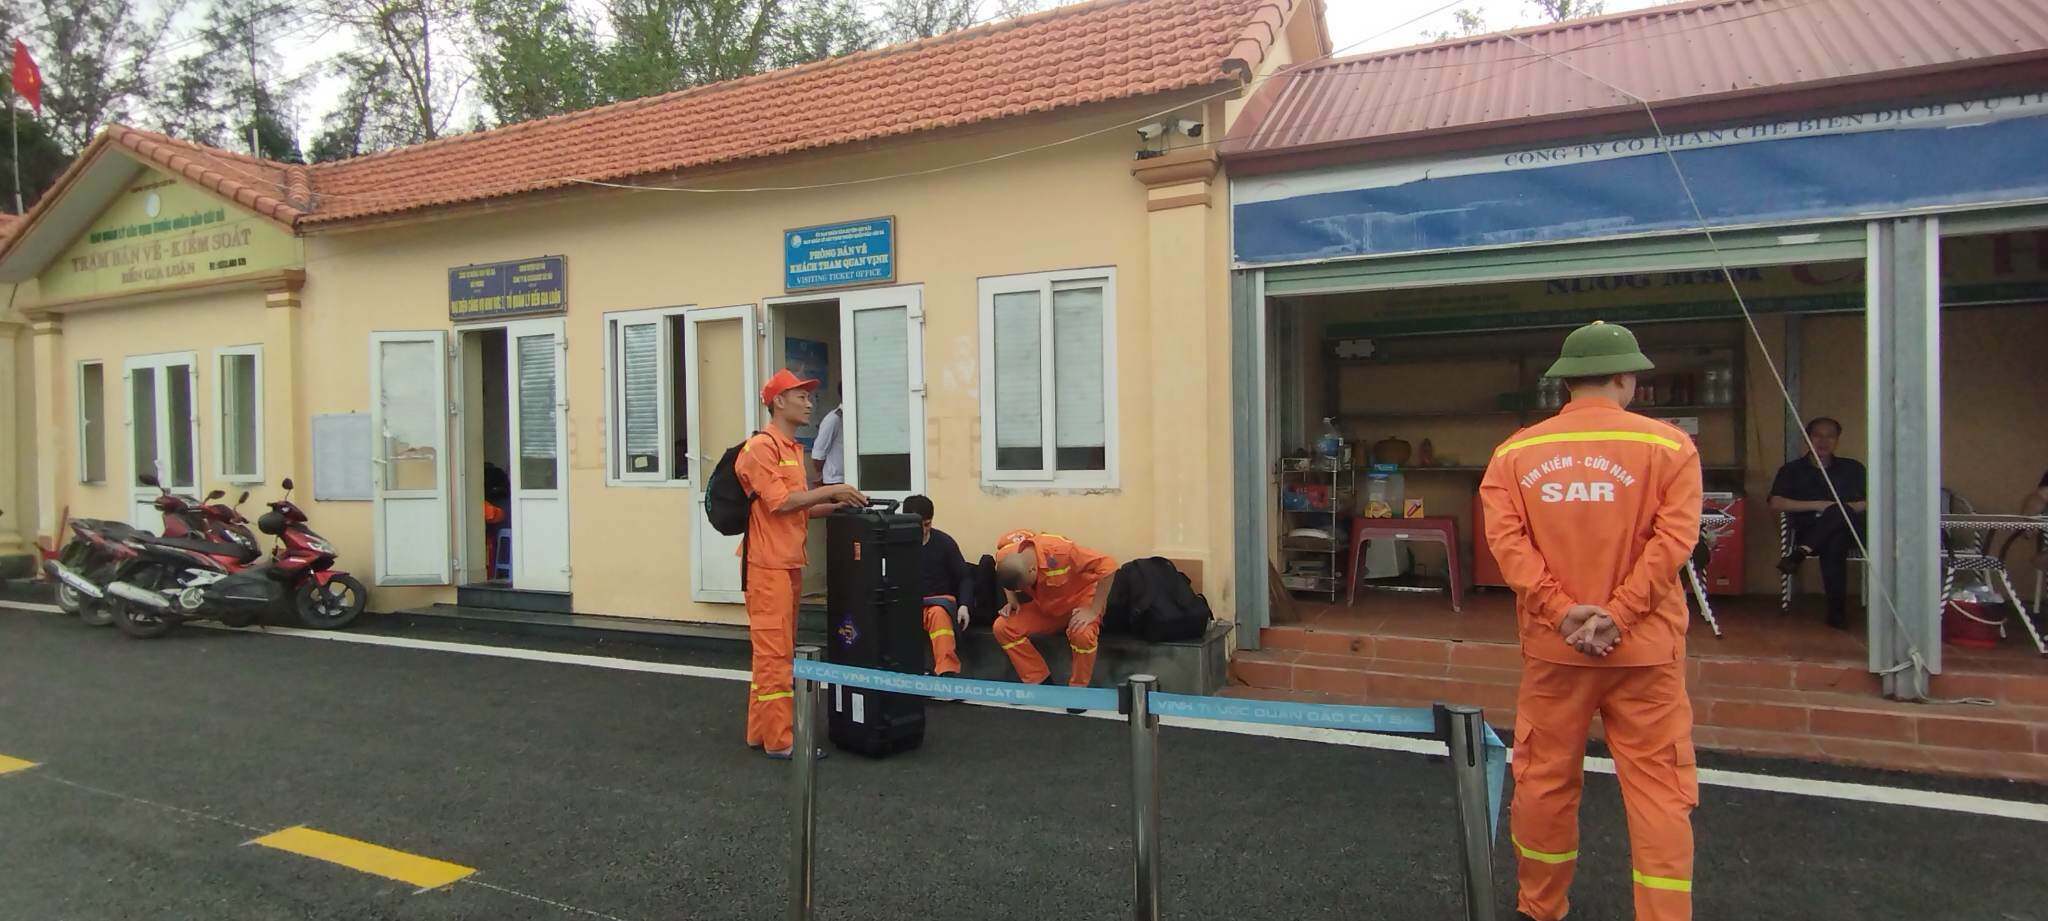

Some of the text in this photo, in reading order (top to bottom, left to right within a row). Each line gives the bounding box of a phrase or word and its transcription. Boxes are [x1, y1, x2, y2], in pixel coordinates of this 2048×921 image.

[1572, 143, 1604, 158] TY
[843, 256, 866, 269] QUAN
[797, 268, 882, 284] VISITING TICKET OFFICE
[1520, 468, 1542, 489] TÌM
[1541, 454, 1573, 475] KIẾM
[1584, 455, 1610, 472] CỨU
[1609, 464, 1636, 487] NẠN
[1541, 481, 1615, 503] SAR
